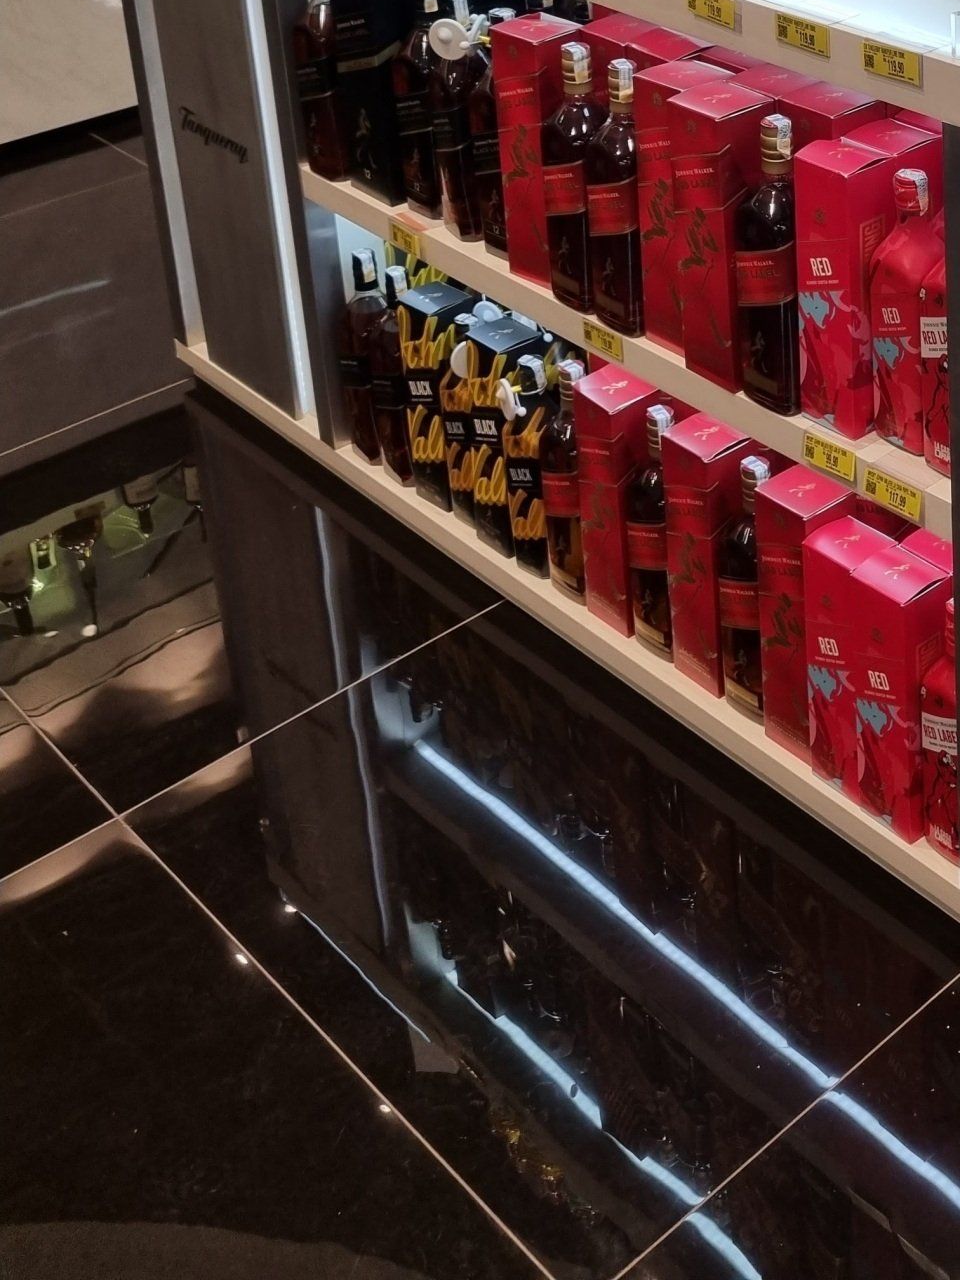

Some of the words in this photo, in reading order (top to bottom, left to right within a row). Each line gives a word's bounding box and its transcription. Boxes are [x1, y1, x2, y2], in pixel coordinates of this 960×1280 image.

[179, 106, 249, 164] Tanqueray
[810, 256, 832, 277] RED
[881, 306, 901, 325] RED
[922, 330, 938, 346] RED
[408, 380, 433, 396] BLACK
[474, 419, 497, 435] BLACK
[509, 468, 533, 481] BLACK
[889, 490, 907, 508] 117,99
[817, 636, 839, 657] RED
[867, 669, 890, 691] RED
[922, 722, 938, 738] RED
[938, 726, 957, 742] LABE
